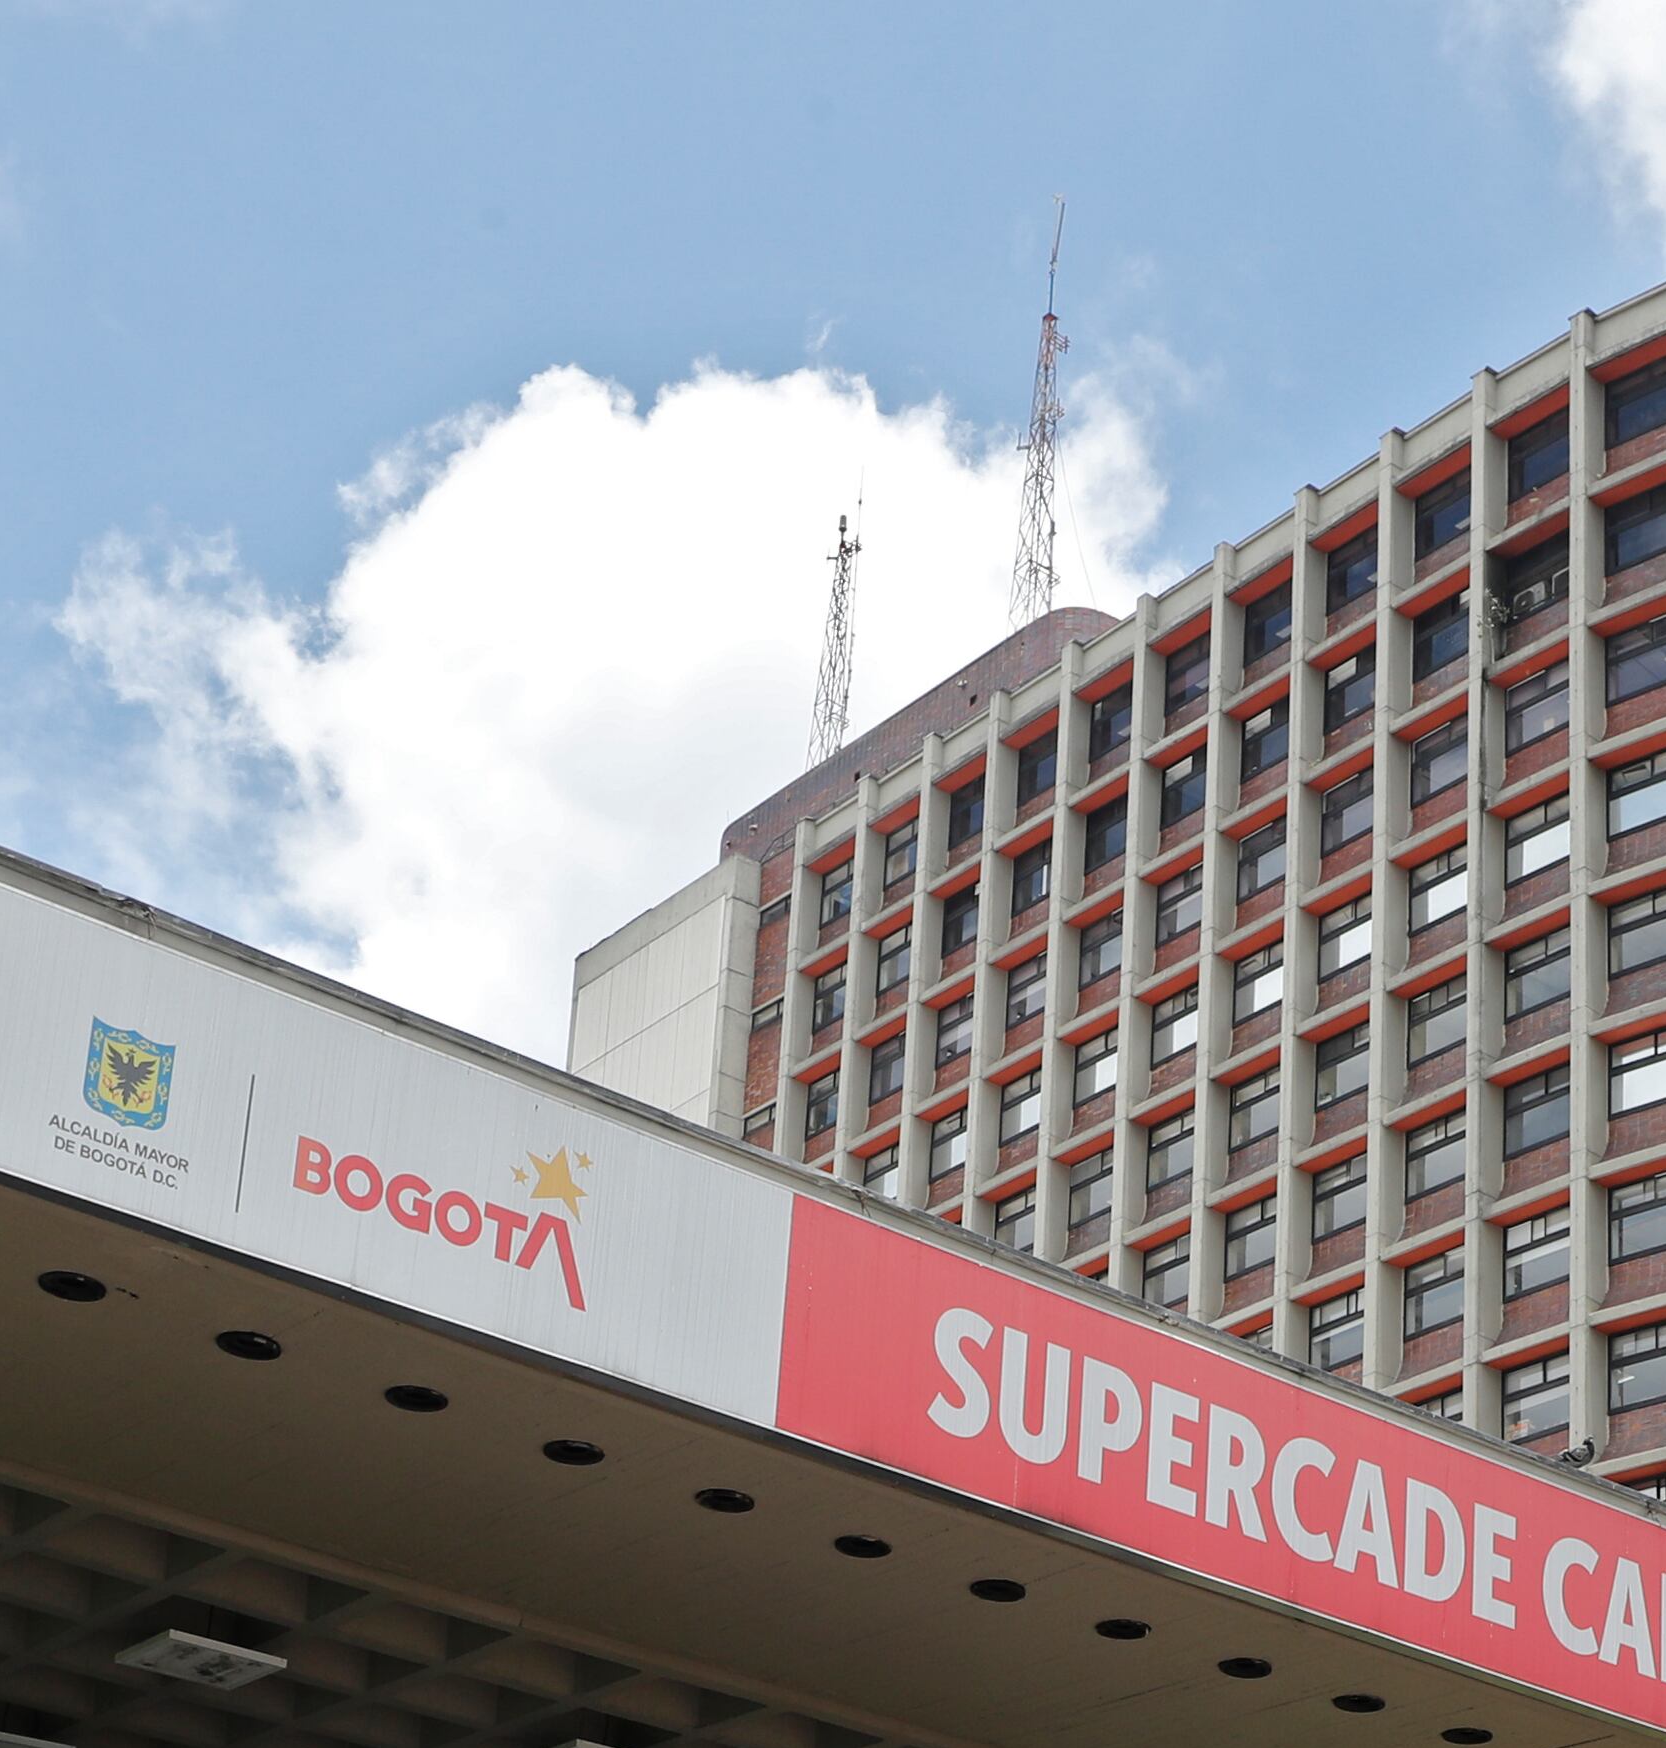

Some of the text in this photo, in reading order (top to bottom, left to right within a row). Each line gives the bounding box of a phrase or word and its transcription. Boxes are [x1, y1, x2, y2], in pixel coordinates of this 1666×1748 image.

[49, 1114, 190, 1173] ALCALDÍA MAYOR
[54, 1135, 179, 1190] DE BOGOTÁ D.C.
[926, 1306, 1518, 1631] SUPERCADE
